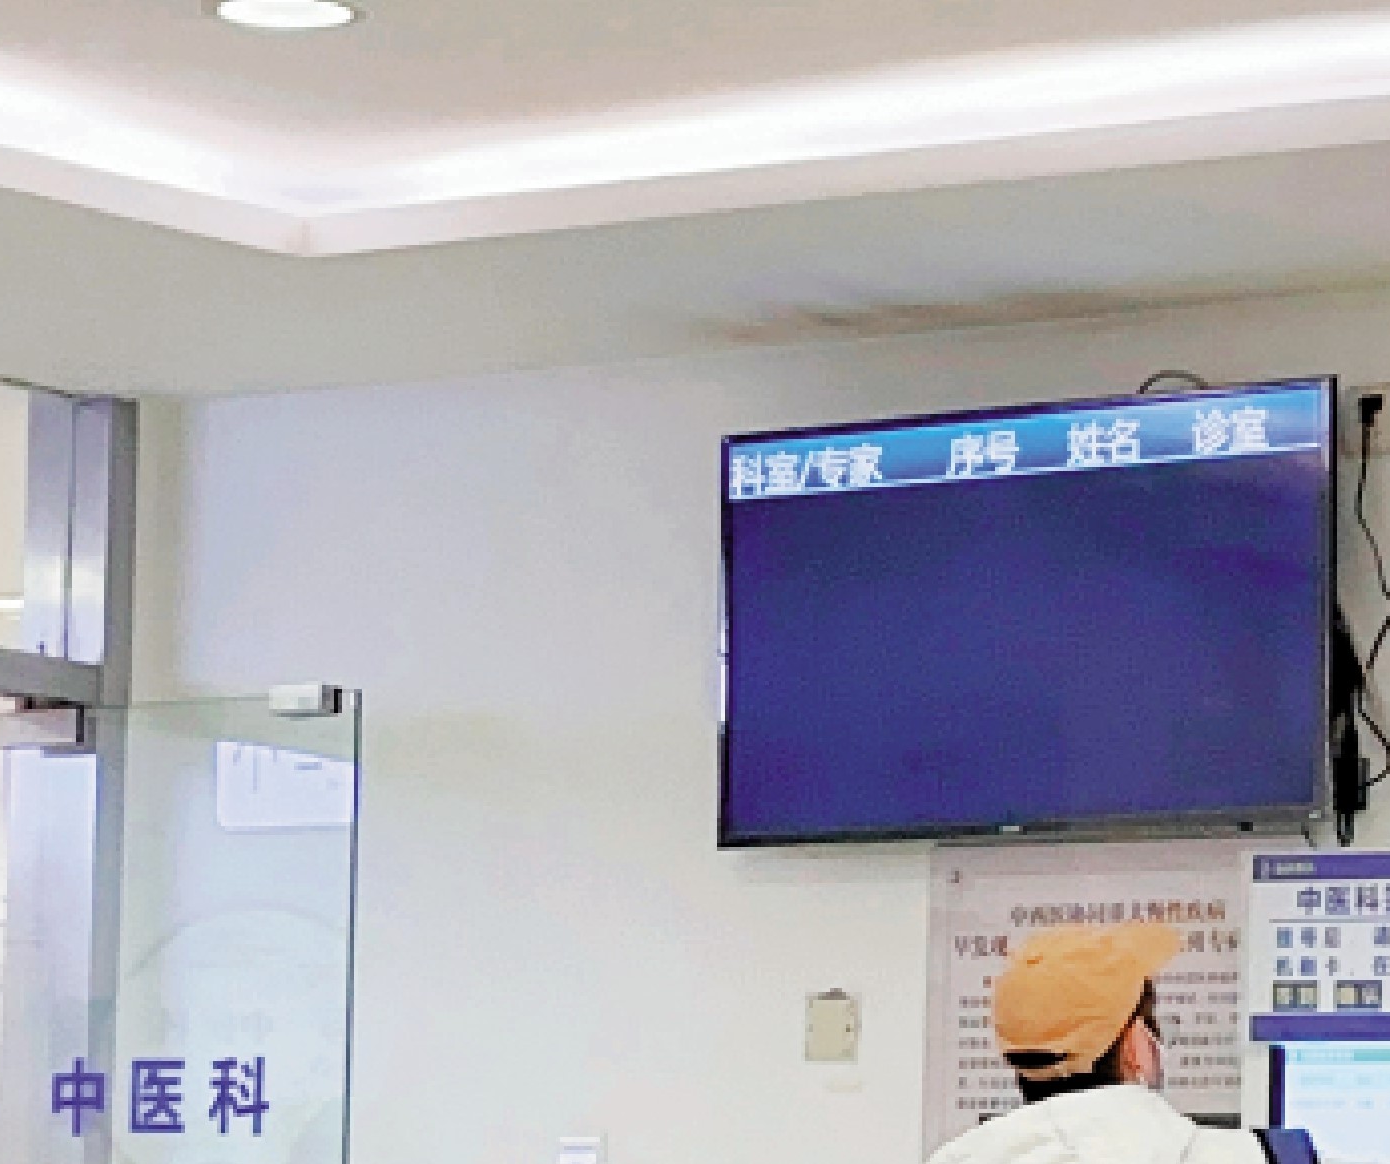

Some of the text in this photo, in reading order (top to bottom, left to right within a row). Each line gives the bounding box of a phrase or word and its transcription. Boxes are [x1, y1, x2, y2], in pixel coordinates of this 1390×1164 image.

[731, 407, 1269, 496] 科室/专家 序号 姓名 诊室
[52, 1057, 269, 1137] 中医科
